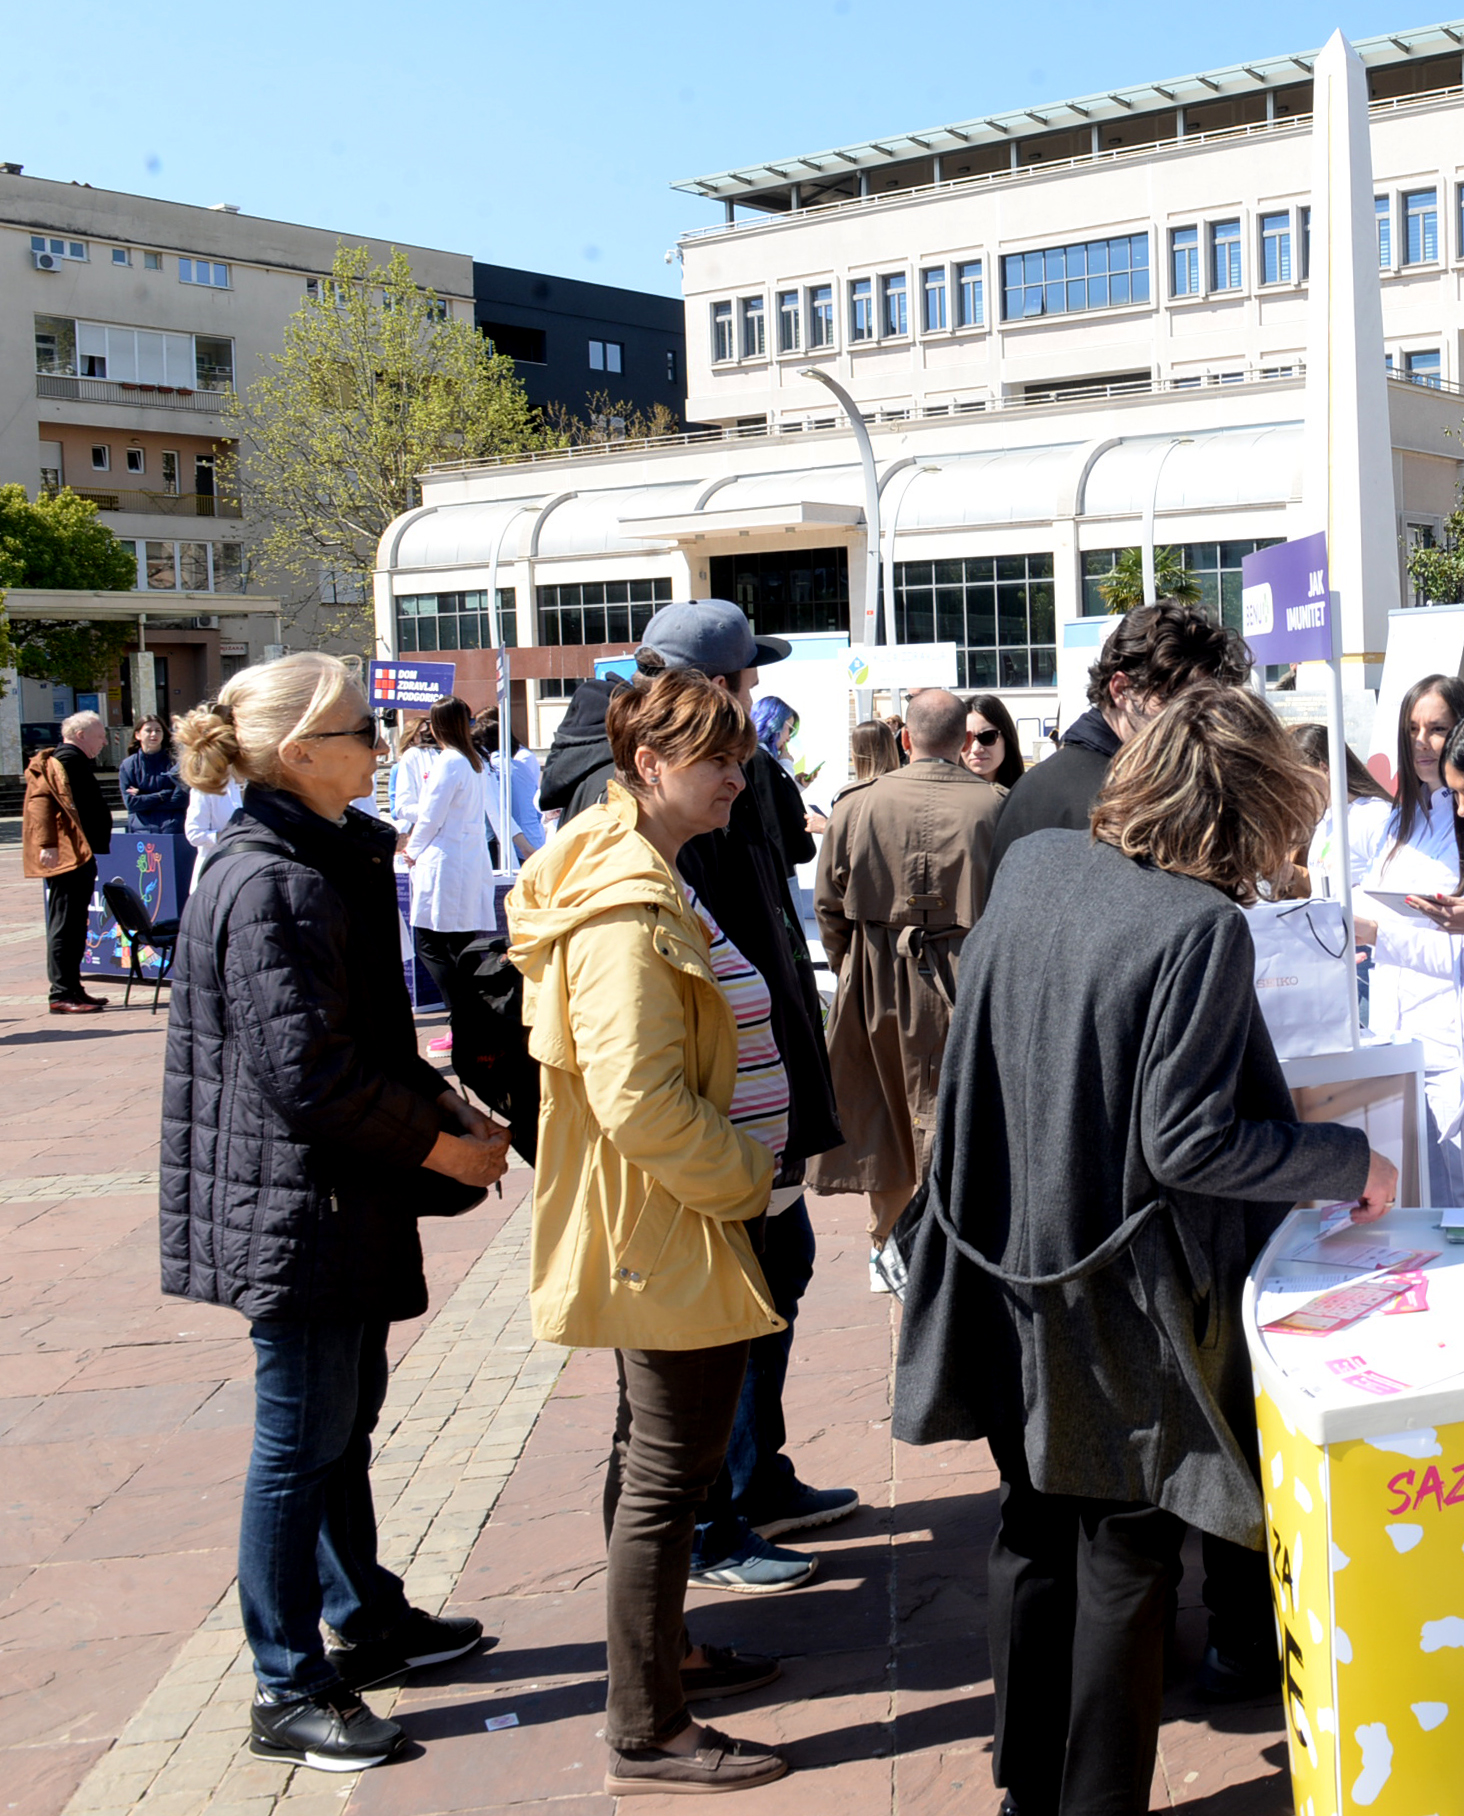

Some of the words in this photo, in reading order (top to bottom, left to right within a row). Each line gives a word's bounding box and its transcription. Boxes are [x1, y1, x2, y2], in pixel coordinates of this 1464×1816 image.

[1308, 569, 1325, 598] JAK
[1286, 601, 1326, 632] IMUNITET
[397, 670, 418, 680] DOM
[397, 680, 439, 692] ZDRAVLJA
[1256, 976, 1298, 989] SEIKO
